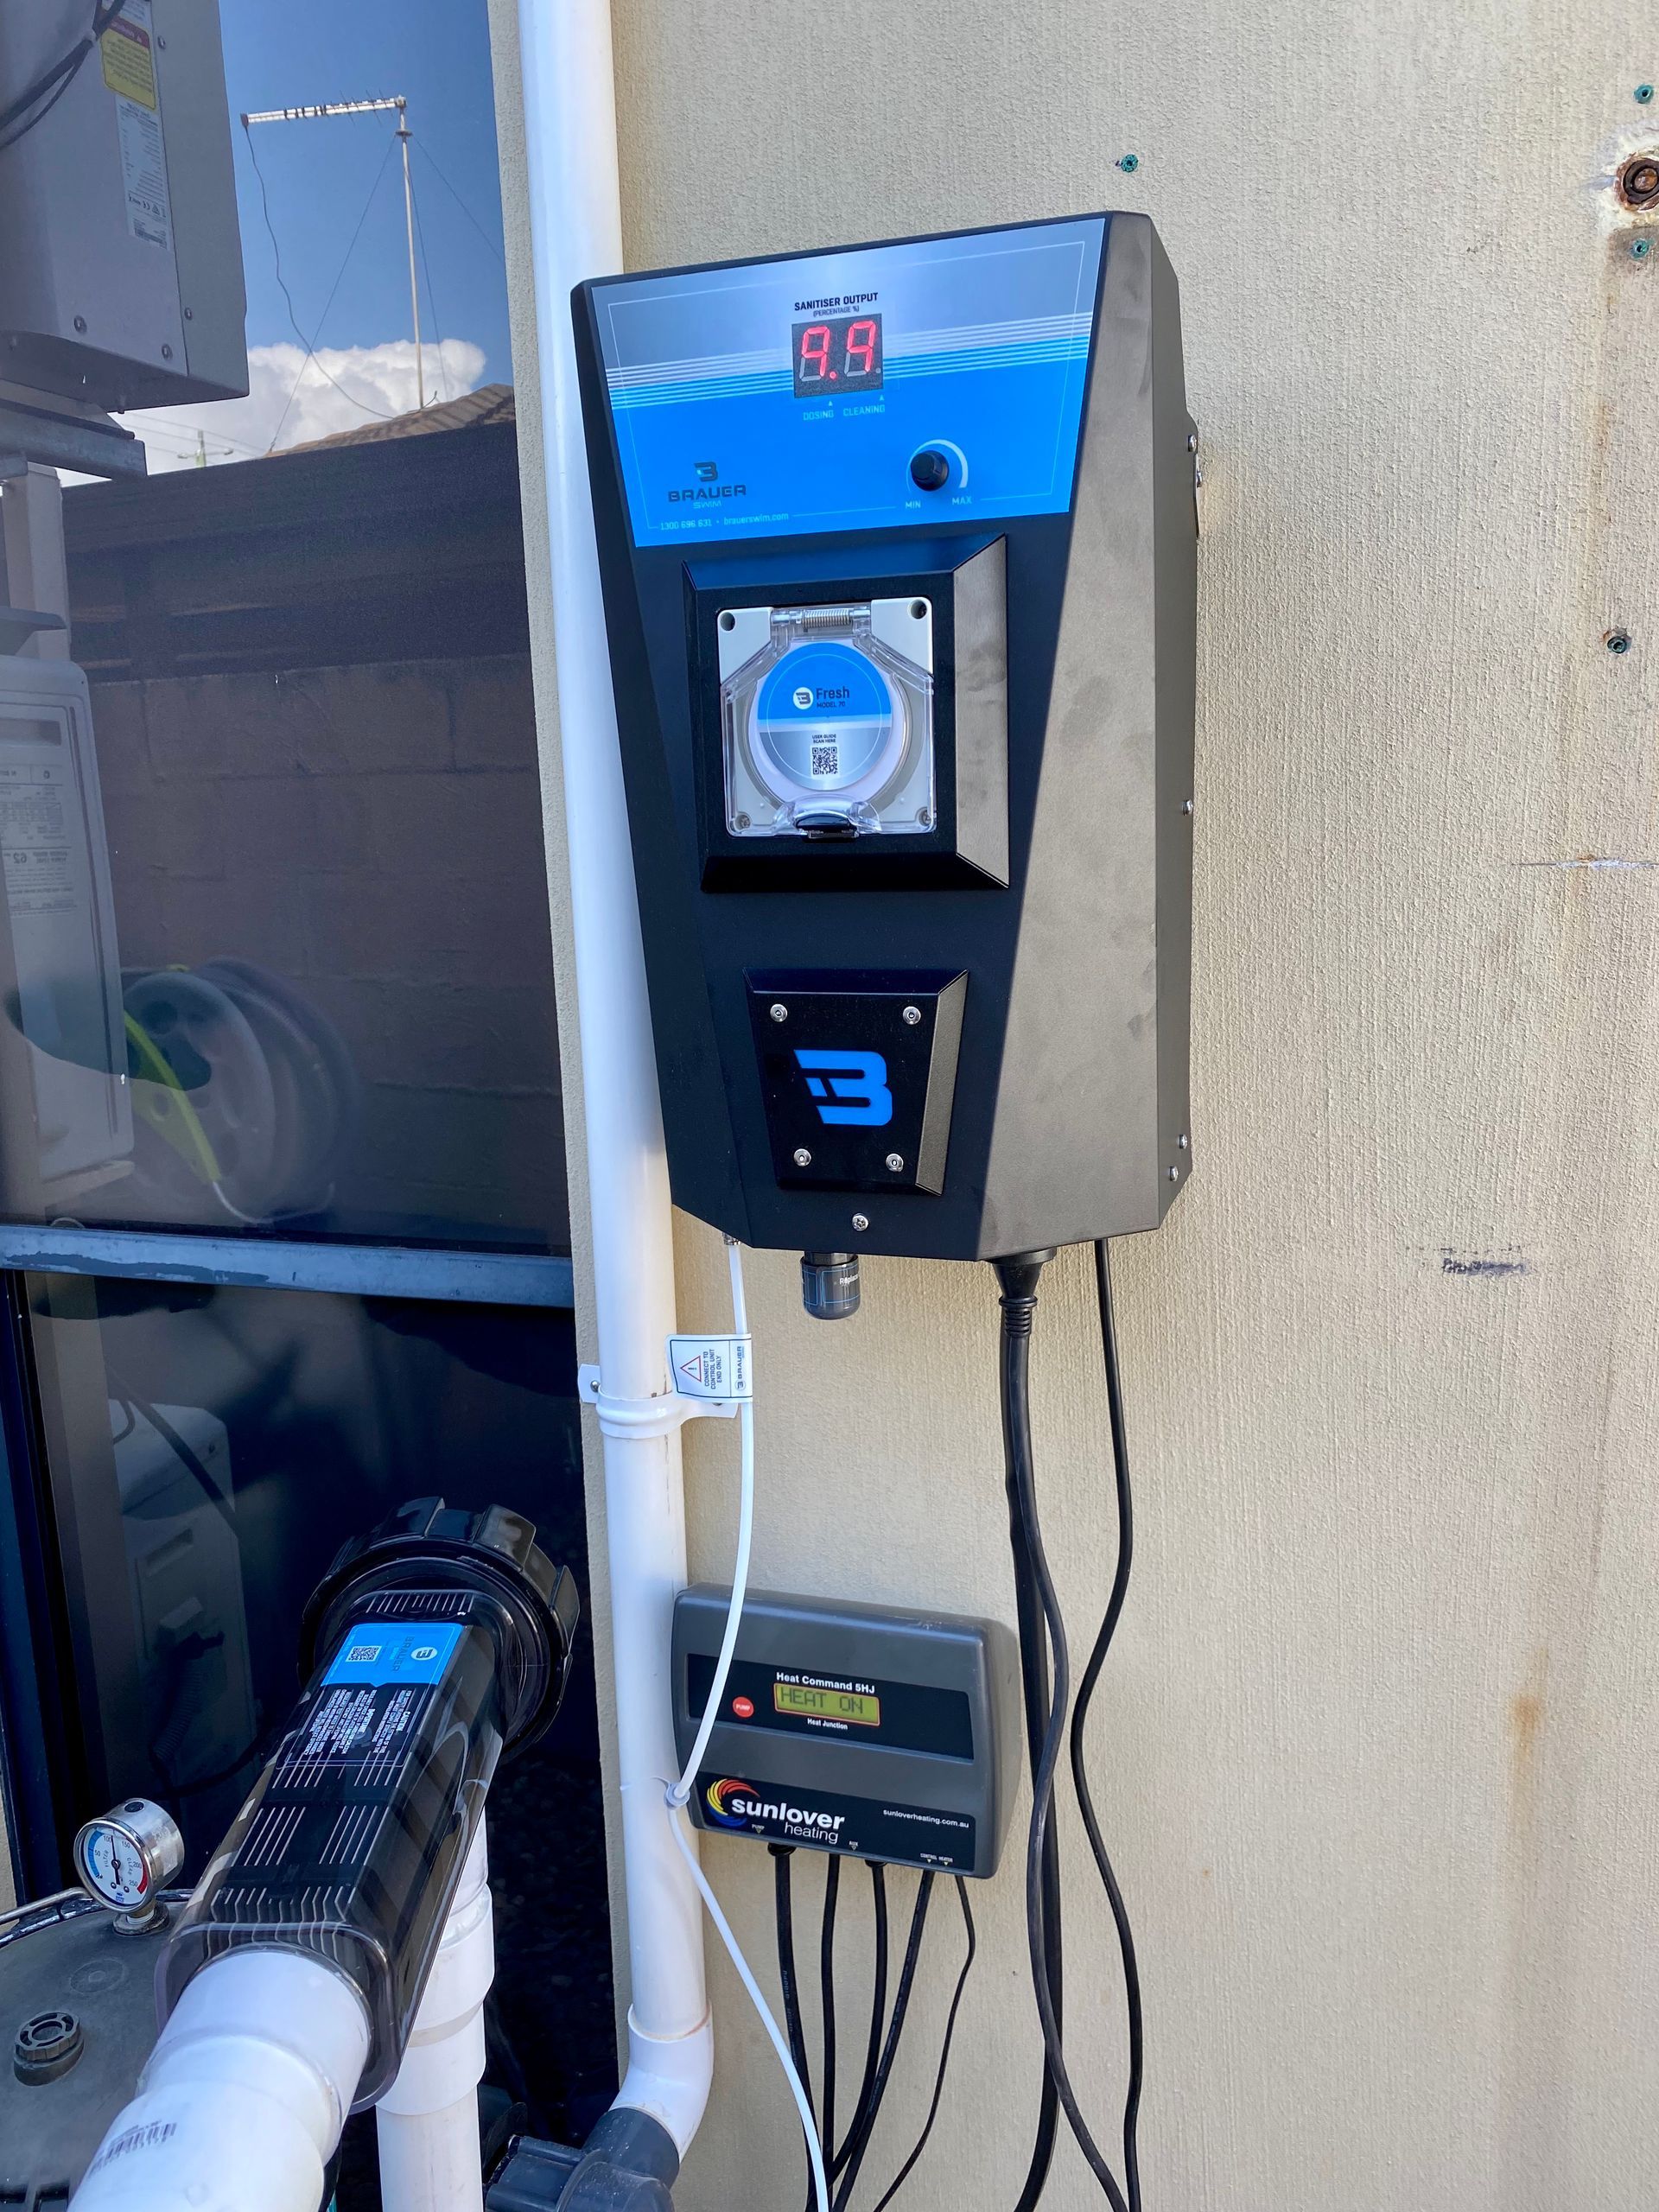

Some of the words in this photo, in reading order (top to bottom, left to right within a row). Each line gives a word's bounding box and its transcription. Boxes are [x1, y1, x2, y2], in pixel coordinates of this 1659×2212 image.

[794, 297, 841, 311] SANITISER
[843, 292, 878, 306] OUTPUT
[801, 325, 876, 378] 9.9
[803, 410, 834, 421] DOSING
[842, 404, 886, 416] CLEANING
[668, 484, 747, 502] BRAUER
[951, 496, 972, 505] MAX
[693, 500, 721, 509] SWIM
[905, 500, 921, 510] MIN
[661, 521, 678, 531] 1300
[697, 518, 712, 528] 631
[724, 513, 789, 526] brauerswim.com
[816, 685, 849, 699] Fresh
[776, 1672, 800, 1683] Heat
[802, 1675, 853, 1691] Command
[855, 1683, 875, 1694] 5HJ
[780, 1687, 827, 1708] HEAT
[839, 1695, 863, 1714] ON
[807, 1718, 822, 1726] Heat
[822, 1719, 848, 1730] Junction
[732, 1798, 846, 1830] sunlover
[883, 1809, 969, 1828] sunloverheating.com.au
[104, 1834, 112, 1843] 100
[785, 1821, 839, 1845] heating
